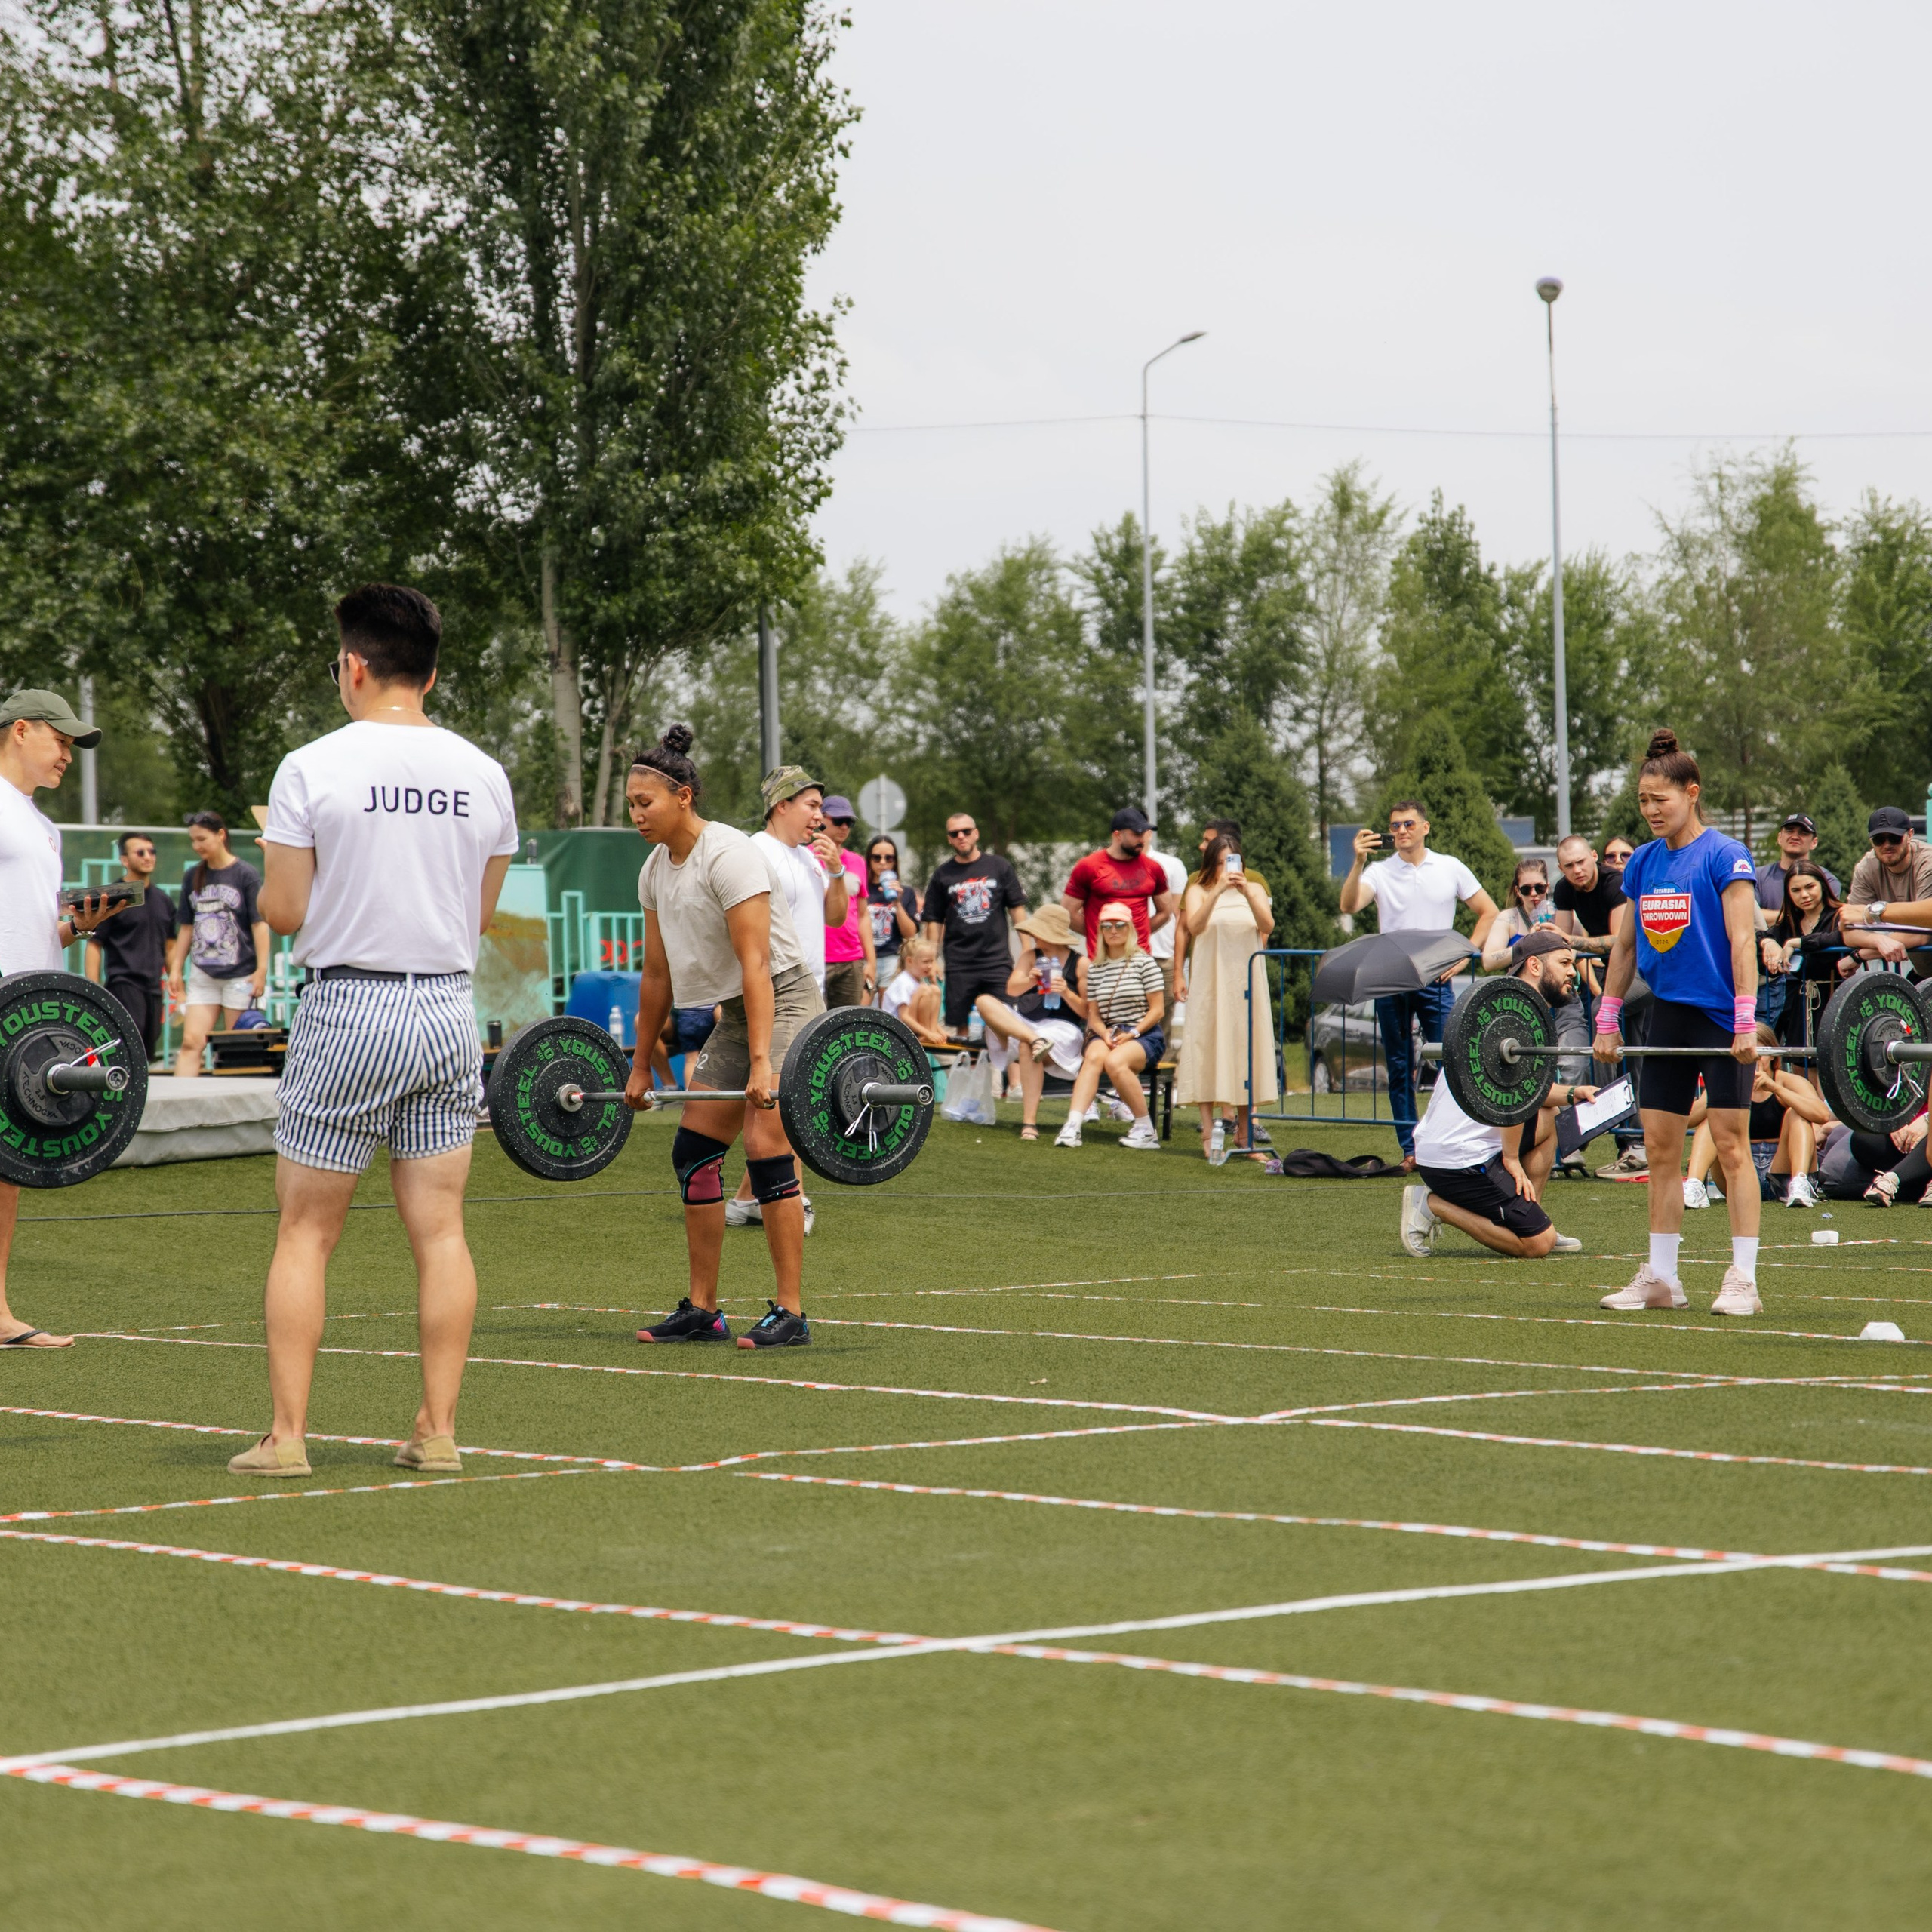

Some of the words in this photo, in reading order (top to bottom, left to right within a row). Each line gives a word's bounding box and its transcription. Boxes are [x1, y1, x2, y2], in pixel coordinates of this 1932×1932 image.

[364, 786, 469, 817] JUDGE
[1641, 898, 1687, 911] EURASIA
[1642, 912, 1687, 921] THROWDOWN
[540, 1041, 555, 1060] 10
[1491, 997, 1545, 1071] YOUSTEL
[810, 1031, 894, 1105] YOUSTEEL
[897, 1062, 914, 1081] 10
[1469, 1031, 1524, 1106] YOUSTEEL
[1846, 1023, 1894, 1112] YOUSTEEL
[35, 1088, 46, 1101] 2.5
[517, 1065, 577, 1158] YOUSTEEL
[843, 1076, 858, 1121] TECHNOGY
[580, 1137, 595, 1155] 10
[833, 1104, 914, 1160] OUSTEEL
